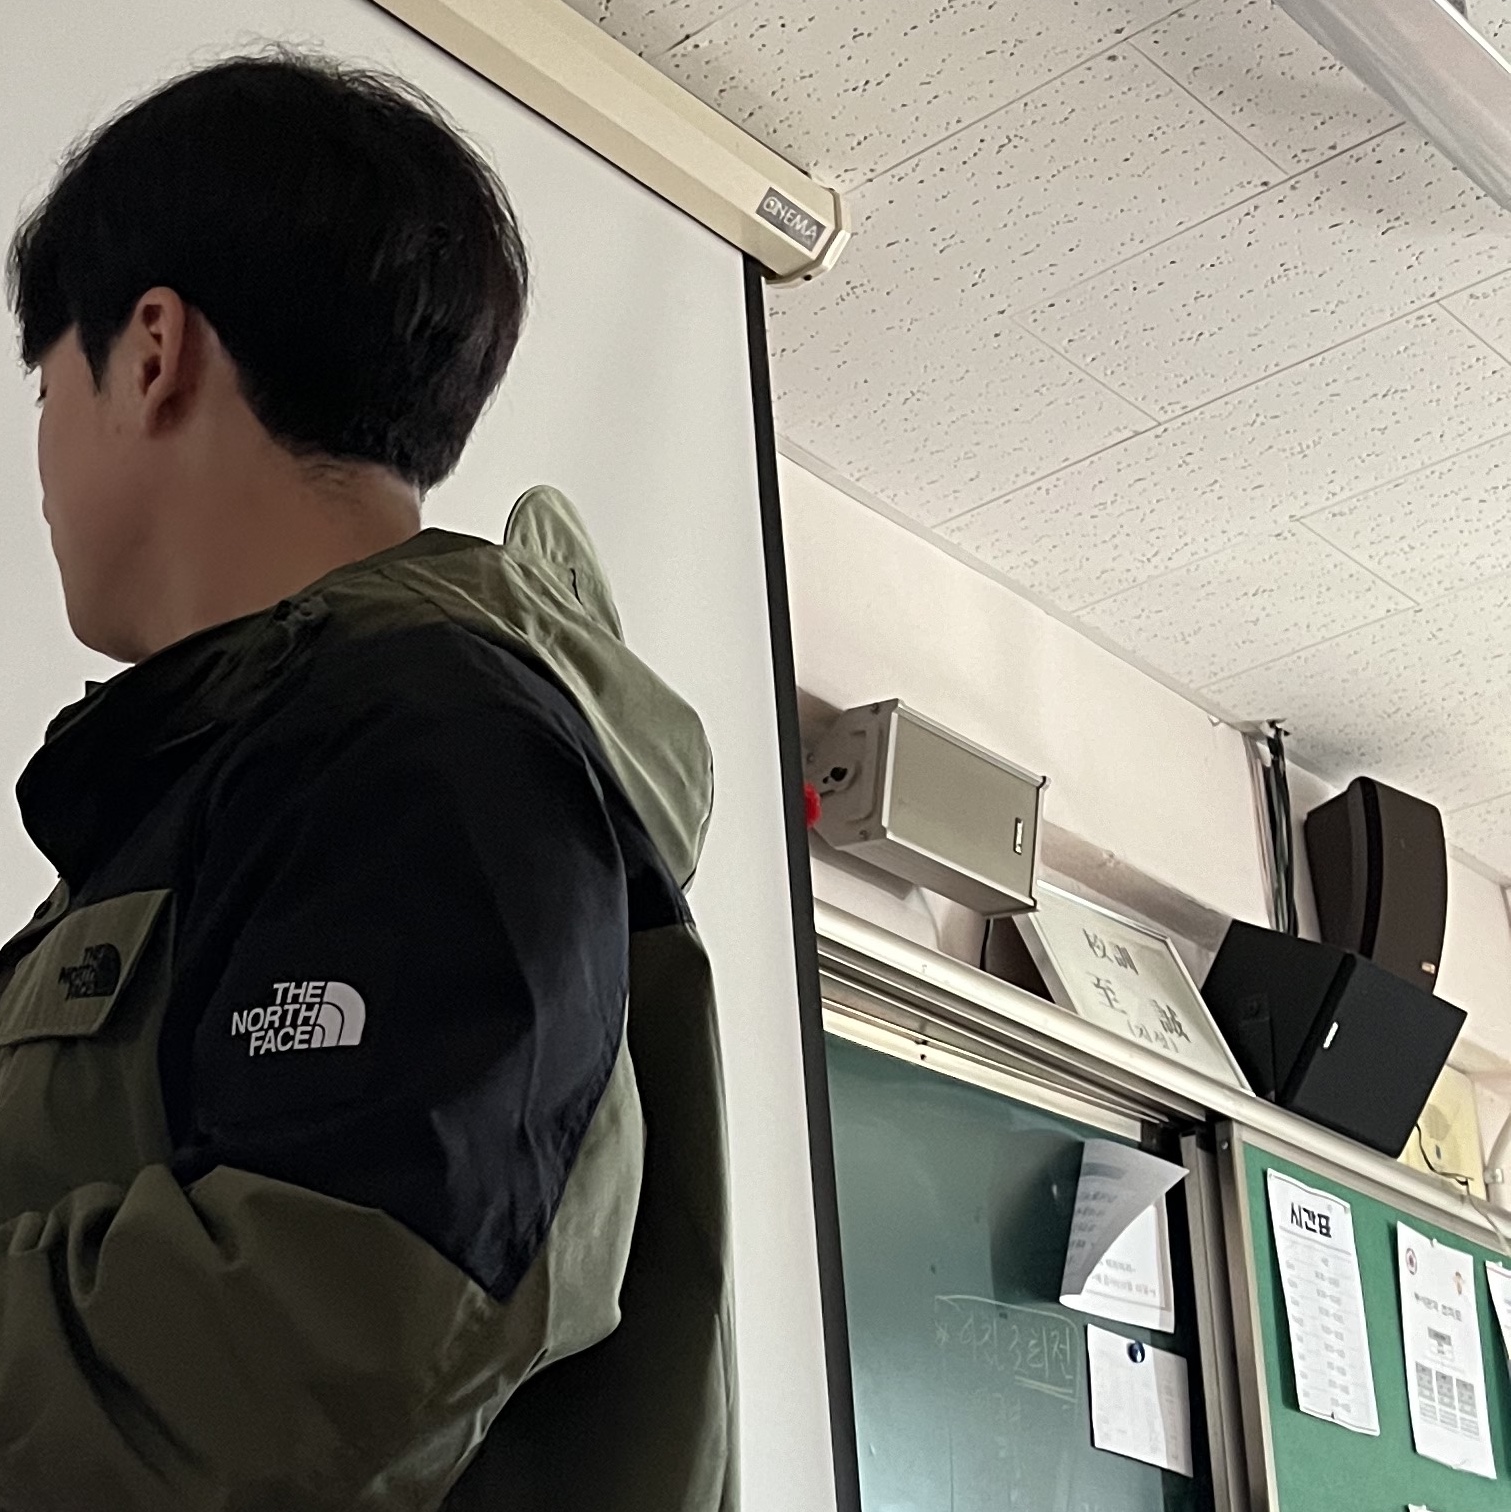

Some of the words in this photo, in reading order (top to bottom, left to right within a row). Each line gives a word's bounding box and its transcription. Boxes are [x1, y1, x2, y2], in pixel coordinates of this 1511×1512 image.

[273, 981, 325, 1005] THE
[231, 1004, 320, 1036] NORTH
[249, 1025, 313, 1057] FACE
[1290, 1202, 1332, 1239] 시간표
